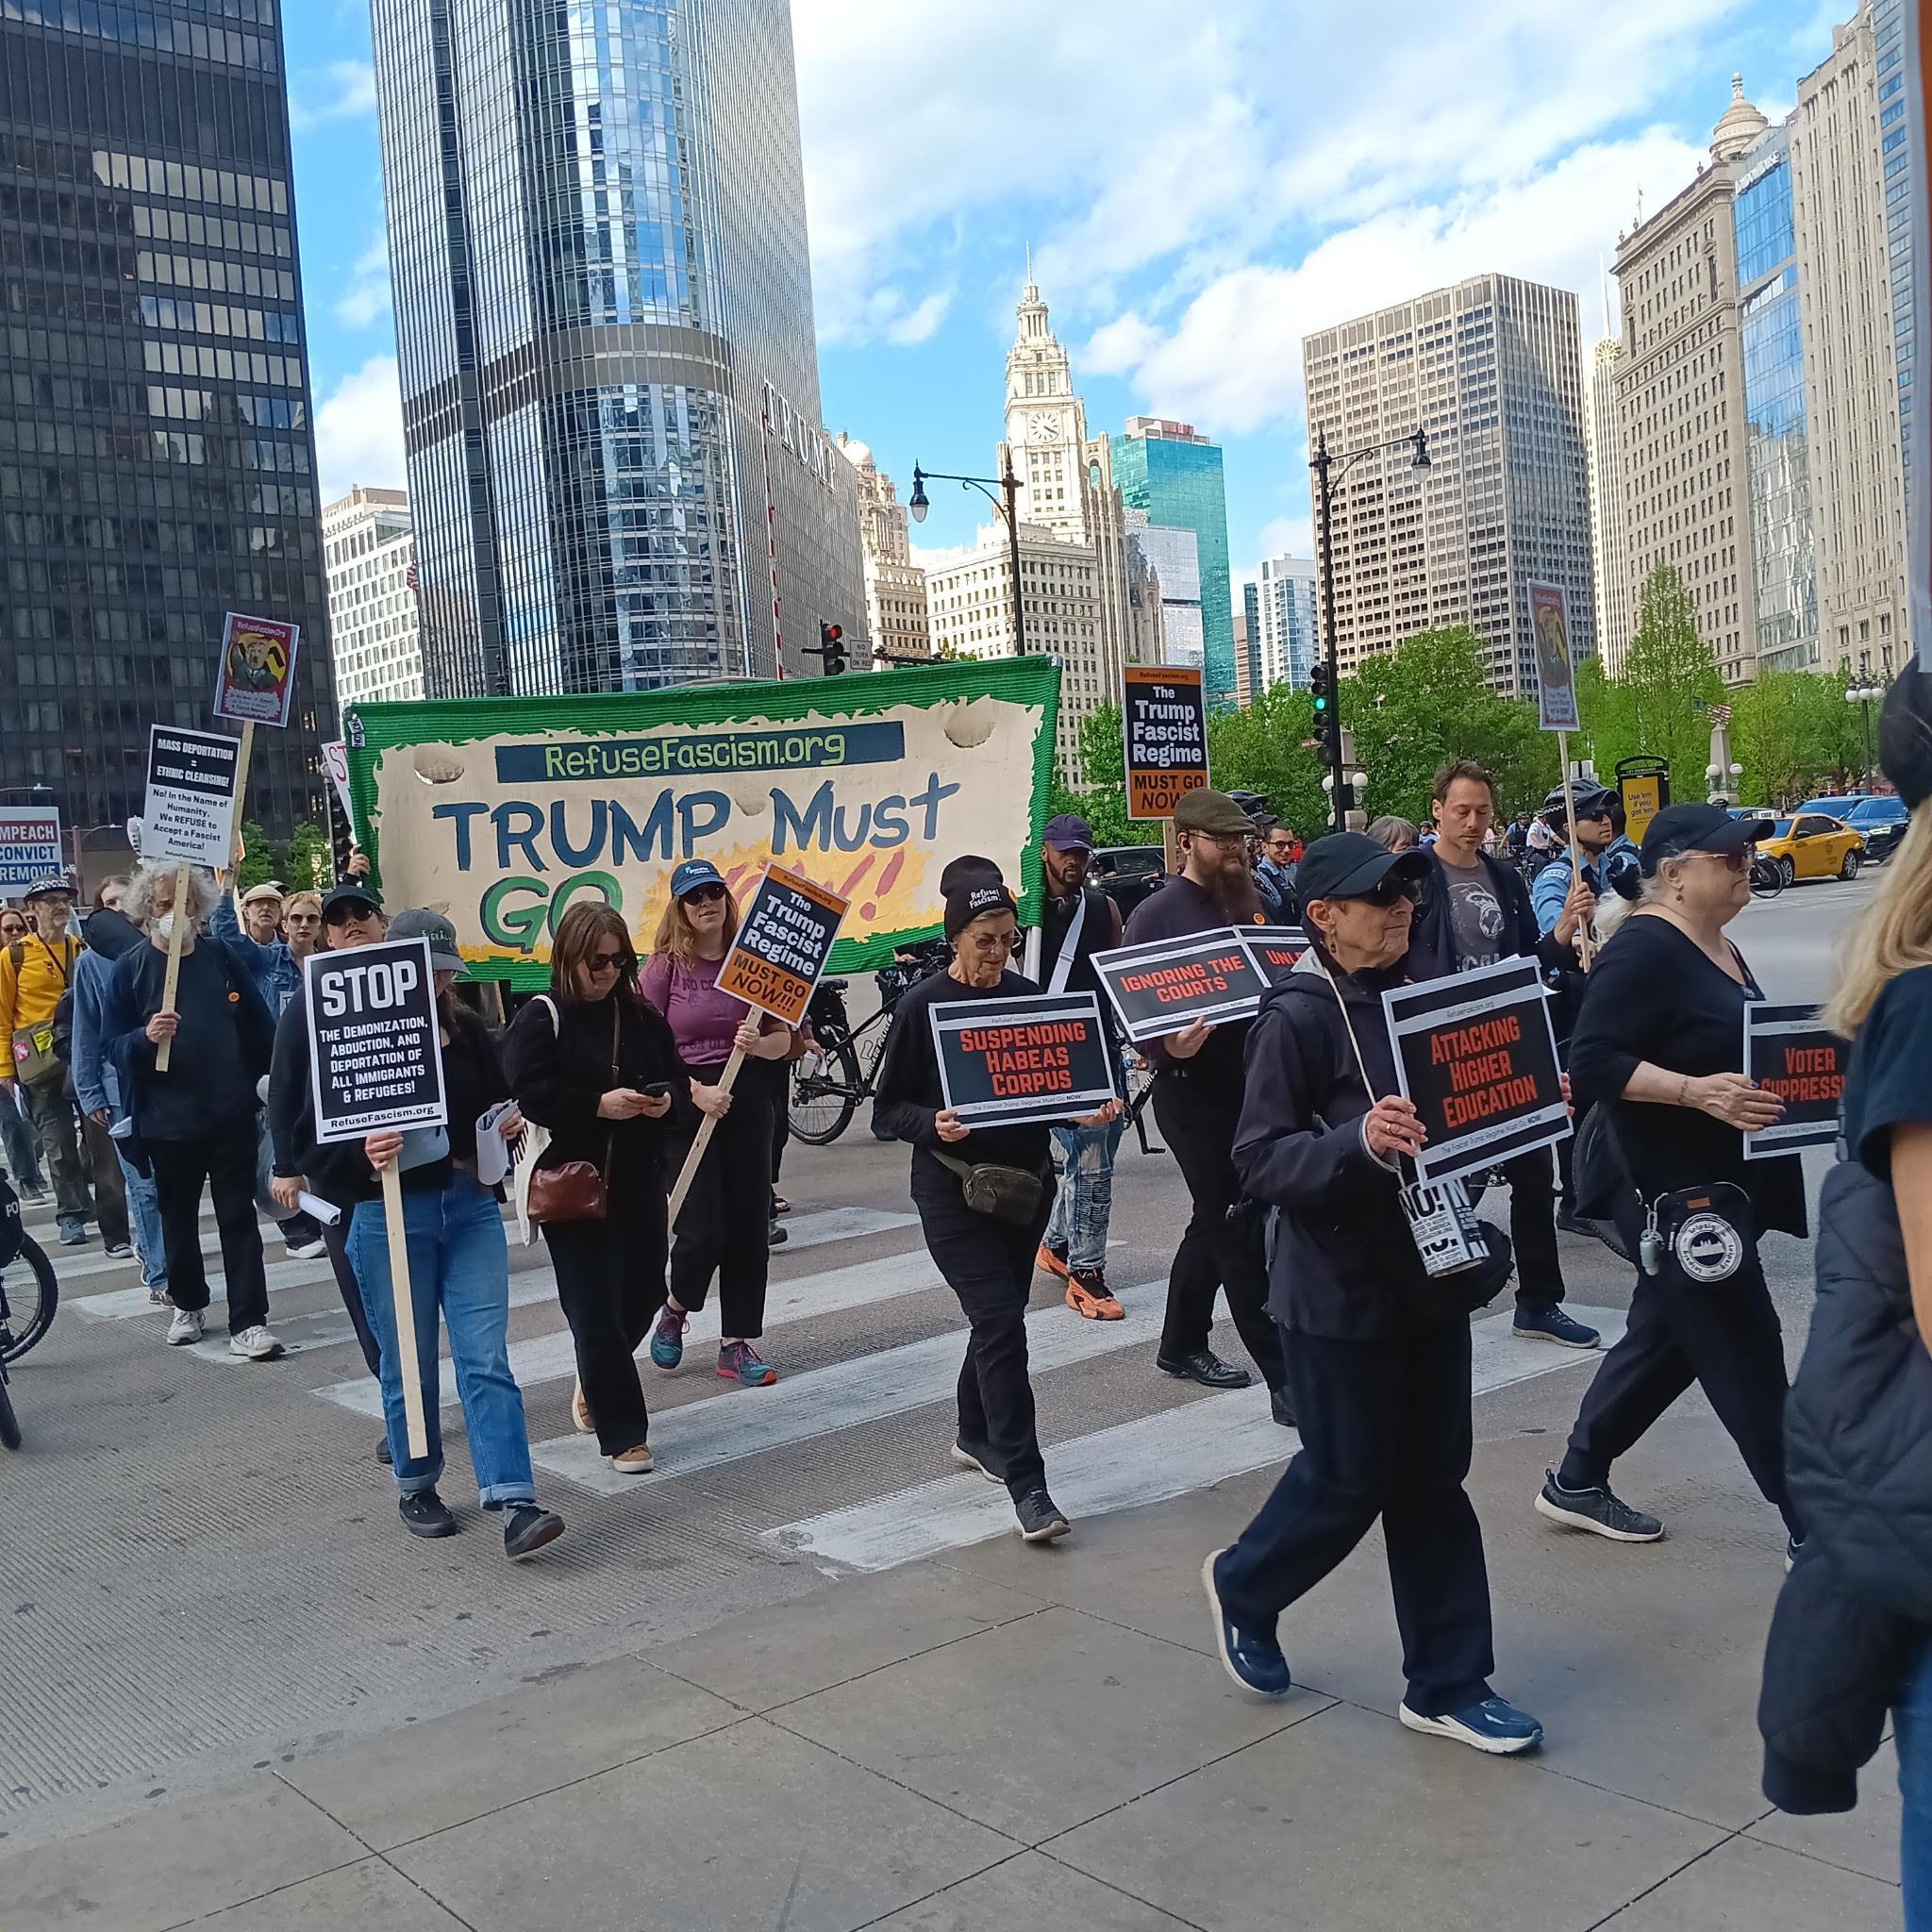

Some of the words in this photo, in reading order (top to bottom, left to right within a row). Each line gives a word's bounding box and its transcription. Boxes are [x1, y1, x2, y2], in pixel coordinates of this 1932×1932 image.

[763, 378, 836, 491] TRUMP
[1153, 686, 1175, 699] The
[1135, 700, 1195, 725] Trump
[1133, 722, 1200, 742] Fascist
[158, 738, 182, 753] MASS
[182, 741, 235, 760] DEPORTATION
[545, 732, 846, 777] RefuseFascism.org
[1133, 743, 1202, 768] Regime
[157, 765, 184, 780] ETHNIC
[185, 770, 230, 788] CLEANSING!
[1134, 774, 1178, 791] MUST
[1183, 774, 1204, 790] GO
[153, 789, 167, 799] No!
[169, 790, 176, 799] In
[178, 791, 192, 803] the
[193, 795, 217, 806] Name
[219, 800, 228, 808] of
[0, 825, 55, 841] MPEACH
[154, 824, 182, 837] Accept
[191, 829, 221, 842] Fascist
[159, 812, 173, 823] We
[175, 814, 206, 828] REFUSE
[208, 821, 217, 830] to
[432, 787, 732, 873] TRUMP
[168, 838, 205, 850] America!
[480, 870, 623, 954] GO
[790, 891, 811, 911] The
[766, 894, 825, 941] Trump
[752, 910, 823, 959] Fascist
[743, 928, 815, 976] Regime
[733, 954, 781, 985] MUST
[783, 978, 807, 999] GO
[1120, 963, 1207, 992] IGNORING
[1208, 955, 1245, 975] THE
[321, 959, 418, 1017] STOP
[732, 972, 797, 1013] NOW!!!
[1156, 975, 1228, 1004] COURTS
[320, 1029, 341, 1043] THE
[343, 1016, 428, 1040] DEMONIZATION,
[958, 1022, 1086, 1052] SUSPENDING
[1429, 1015, 1521, 1066] ATTACKING
[330, 1038, 394, 1058] ABDUCTION,
[397, 1032, 421, 1046] AND
[330, 1051, 405, 1074] DEPORTATION
[408, 1048, 423, 1061] OF
[985, 1046, 1070, 1074] HABEAS
[1449, 1050, 1513, 1092] HIGHER
[1785, 1047, 1835, 1074] VOTER
[331, 1074, 352, 1090] ALL
[355, 1064, 425, 1086] IMMIGRANTS
[991, 1069, 1073, 1096] CORPUS
[342, 1091, 352, 1104] &
[355, 1080, 416, 1102] REFUGEES!
[1441, 1074, 1539, 1129] EDUCATION
[331, 1107, 434, 1128] RefuseFascism.org
[1399, 1183, 1445, 1223] NO!
